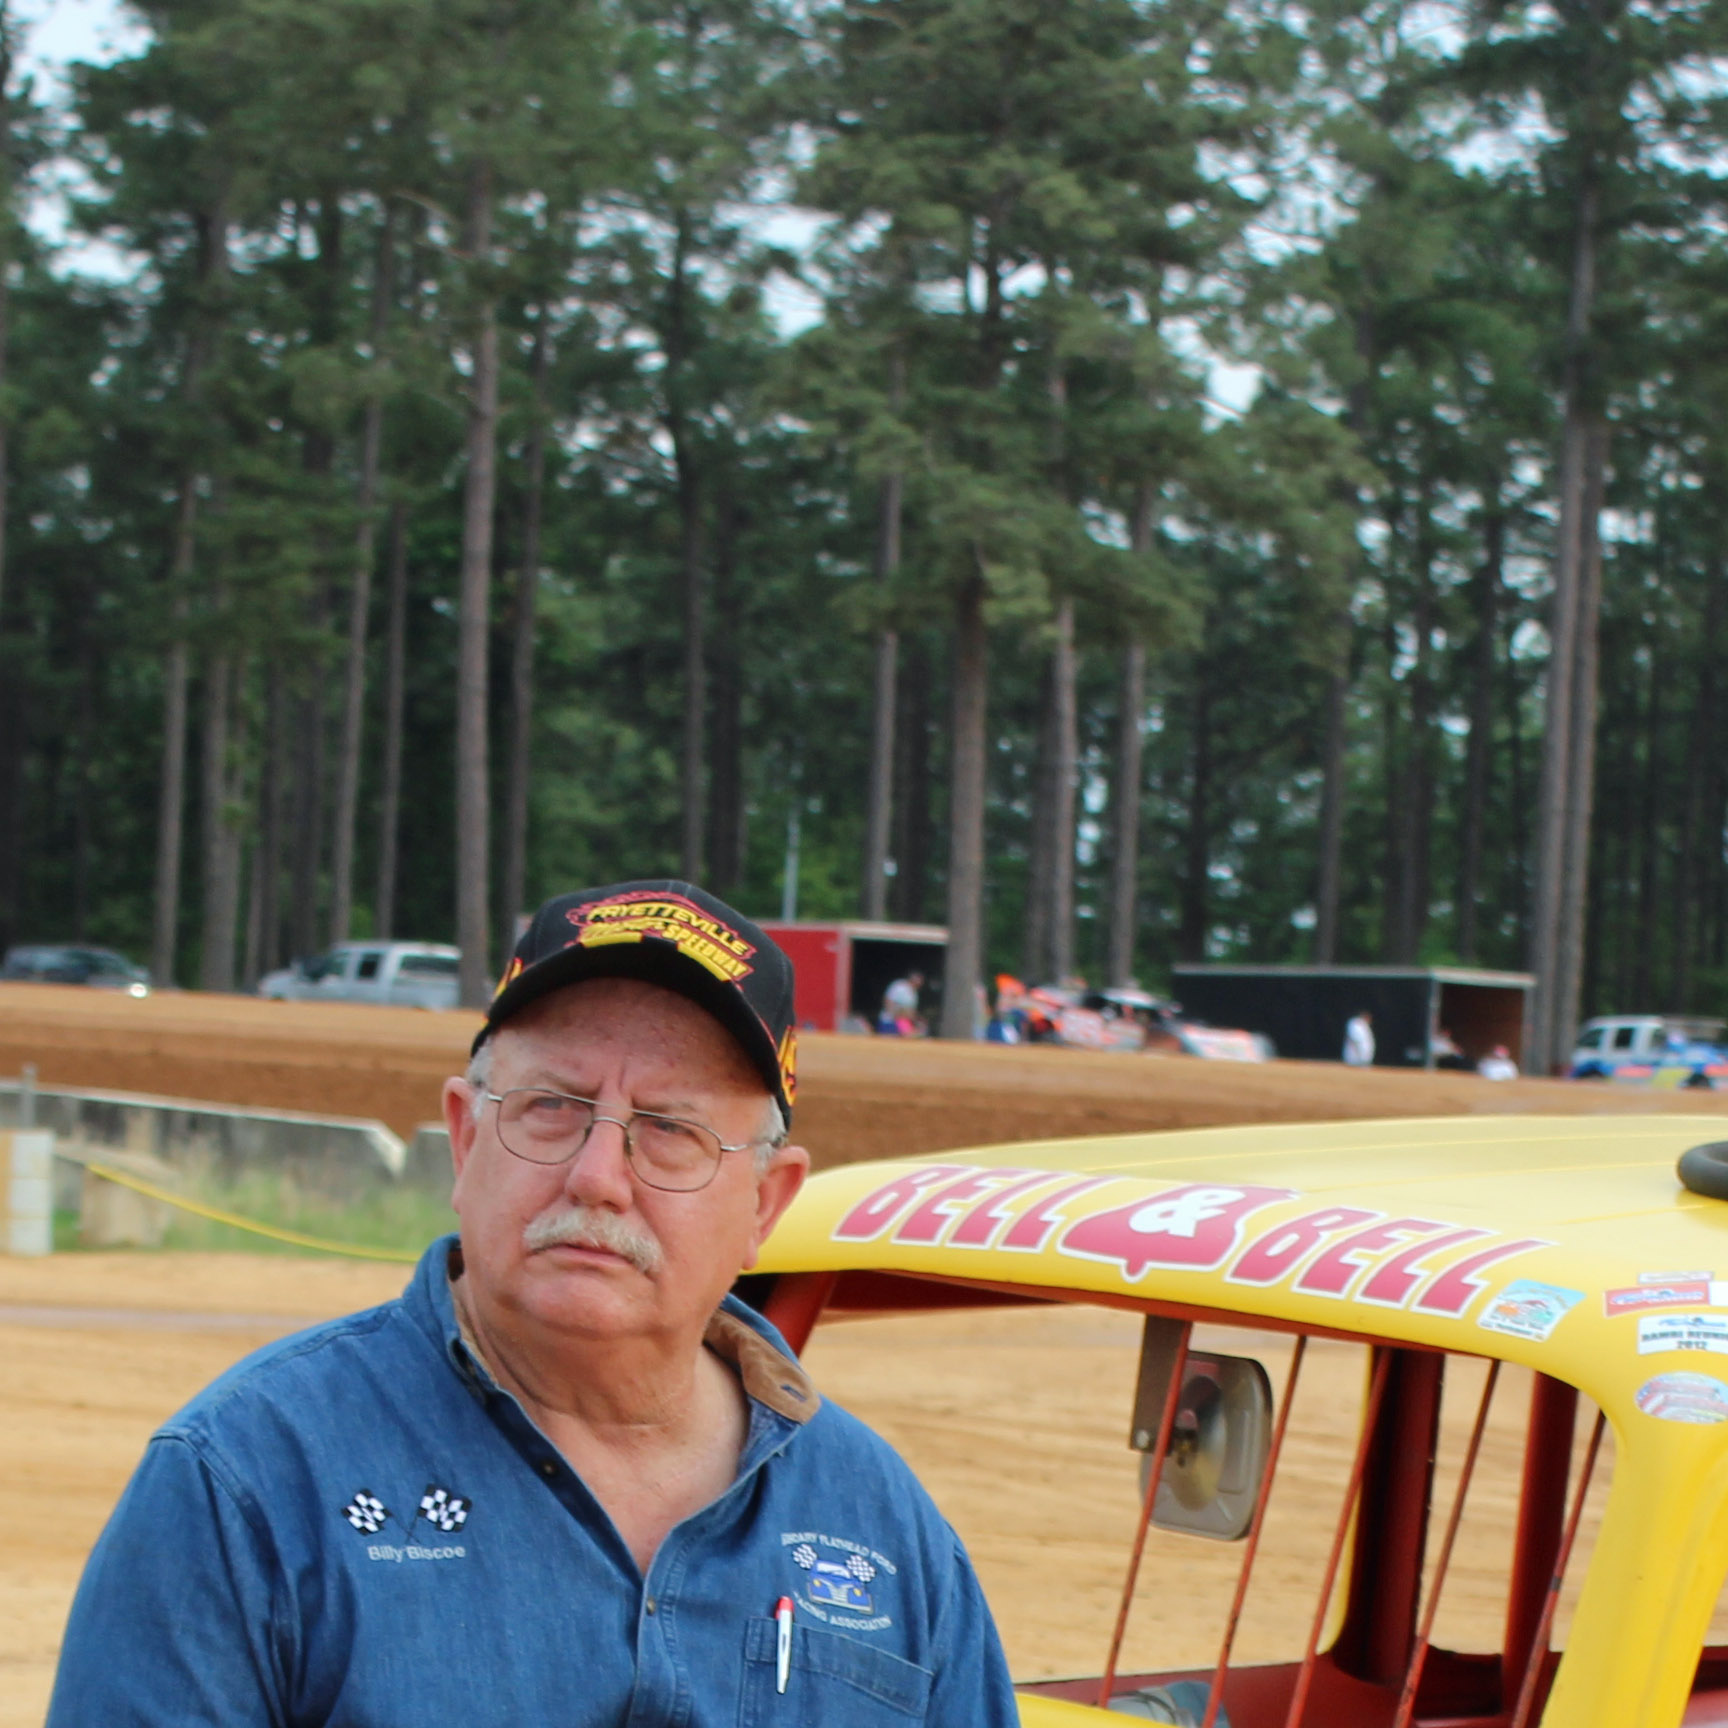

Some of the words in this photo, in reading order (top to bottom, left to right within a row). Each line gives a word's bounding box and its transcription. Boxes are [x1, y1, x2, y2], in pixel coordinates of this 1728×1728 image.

[586, 902, 749, 956] FAYETTEVILLE
[661, 924, 749, 978] SPEEDWAY
[830, 1164, 1136, 1254] BELL
[1129, 1187, 1230, 1239] &
[1225, 1206, 1560, 1320] BELL
[366, 1545, 403, 1563] Billy
[406, 1545, 467, 1560] Biscoe
